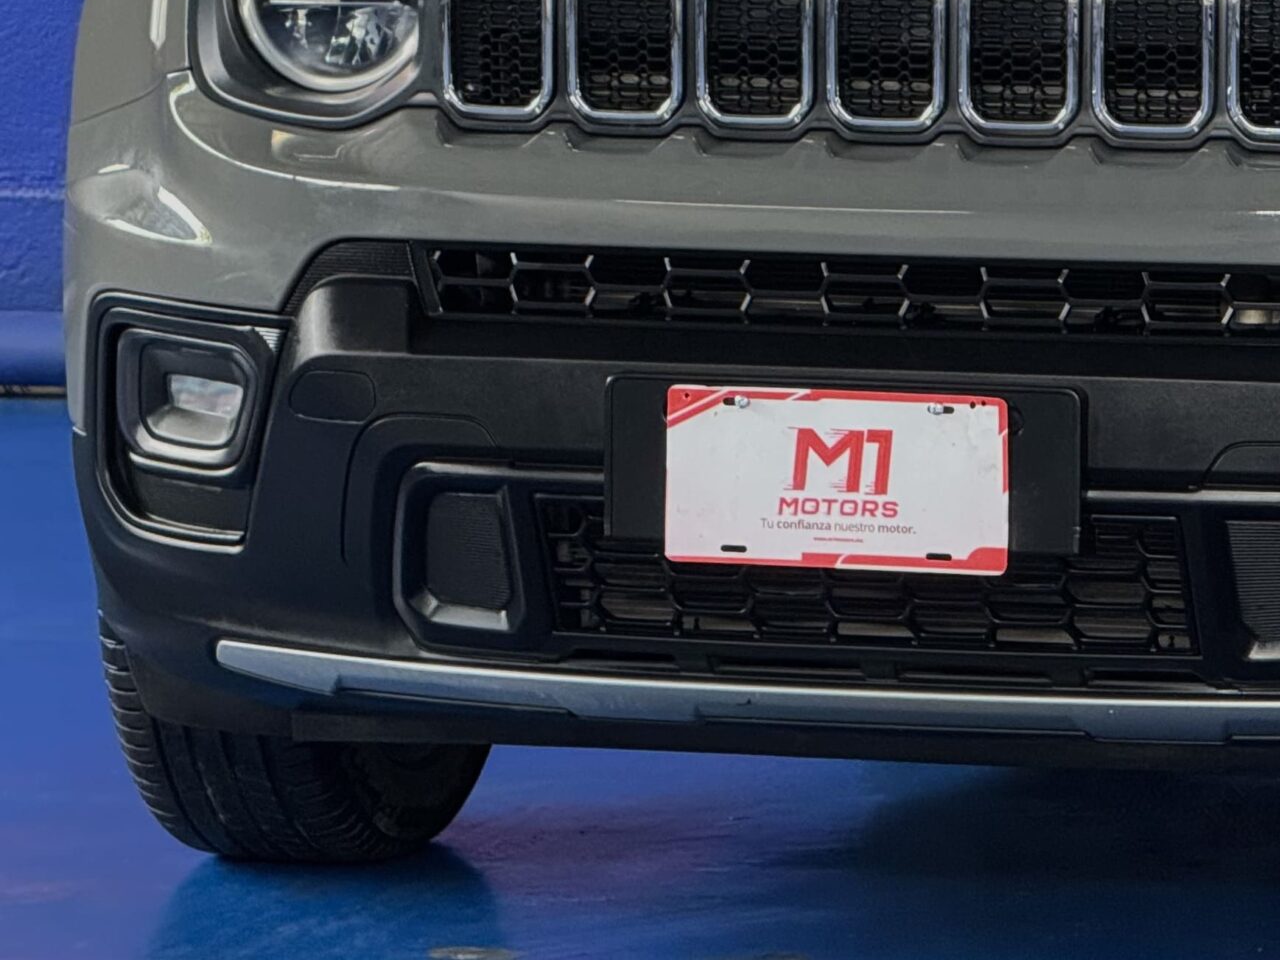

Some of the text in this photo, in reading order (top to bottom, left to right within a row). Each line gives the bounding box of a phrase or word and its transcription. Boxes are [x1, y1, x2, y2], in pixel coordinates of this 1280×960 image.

[786, 426, 893, 495] M1
[777, 497, 900, 518] MOTORS
[760, 518, 918, 535] Tu confianza nuestro motor.
